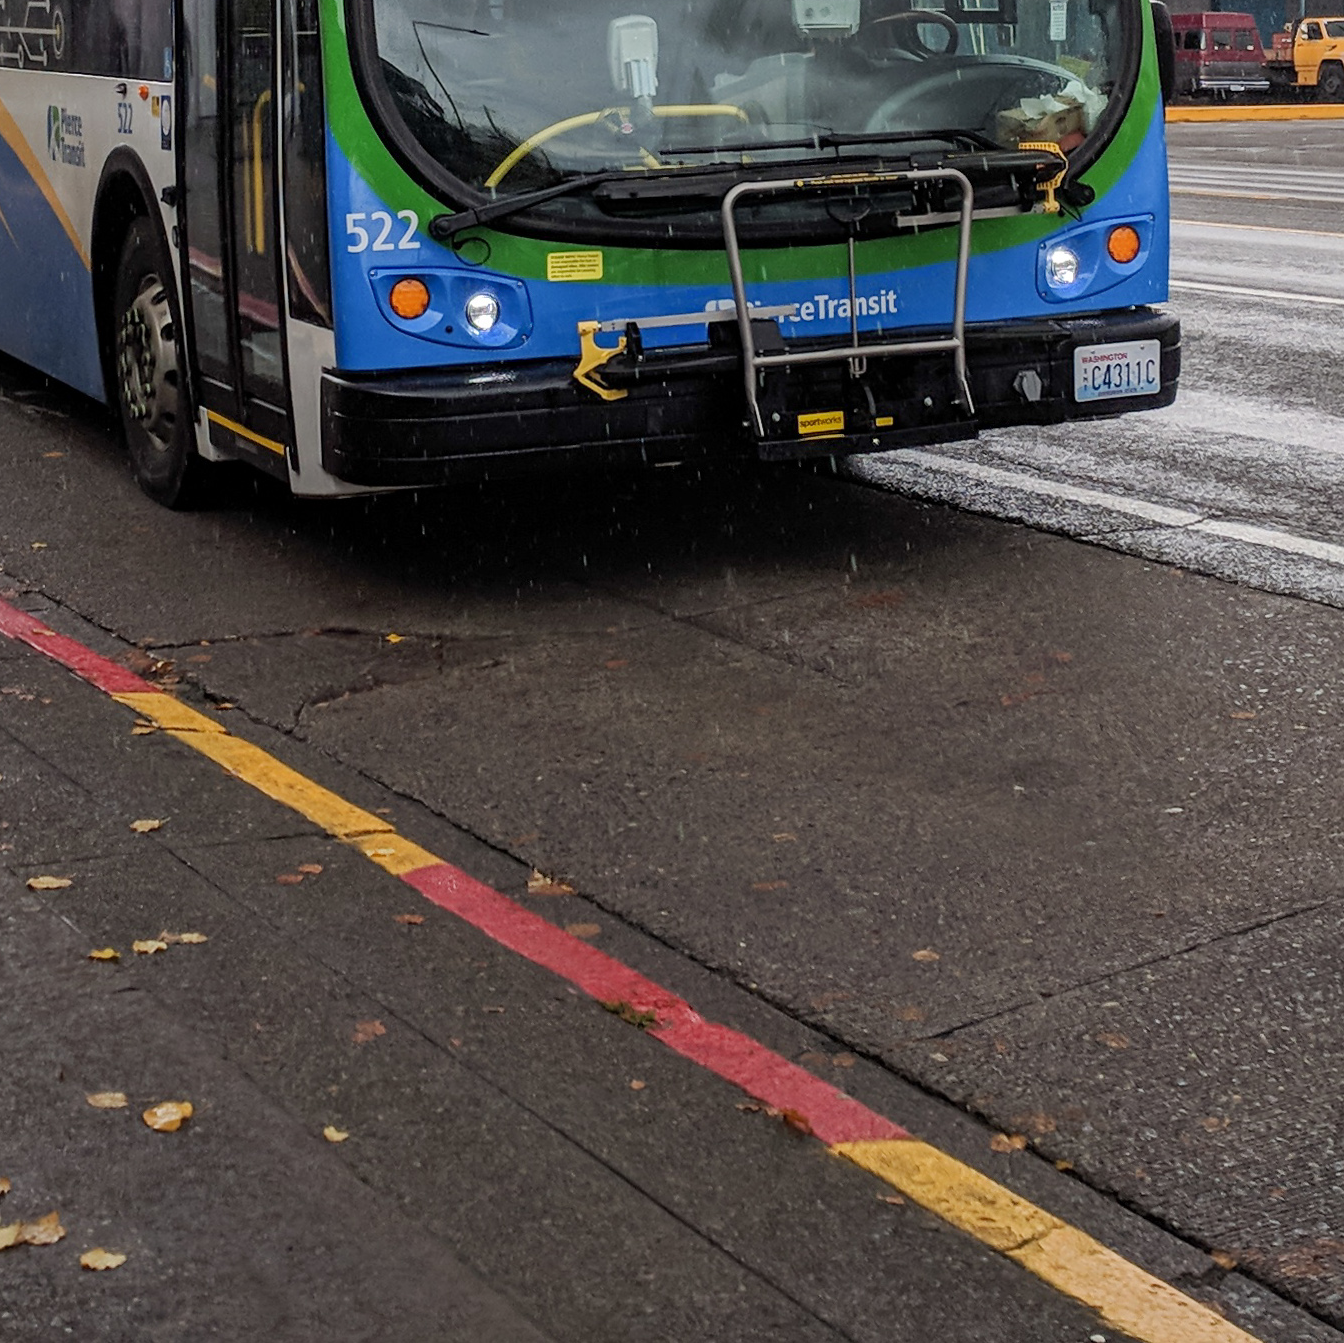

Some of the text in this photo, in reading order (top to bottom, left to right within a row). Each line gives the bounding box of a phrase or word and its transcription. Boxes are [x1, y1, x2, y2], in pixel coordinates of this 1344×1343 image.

[118, 102, 133, 134] 522
[345, 210, 421, 253] 522
[746, 289, 898, 324] ceTransit
[1081, 352, 1128, 364] WASHINGTON
[1092, 359, 1155, 391] C4311C
